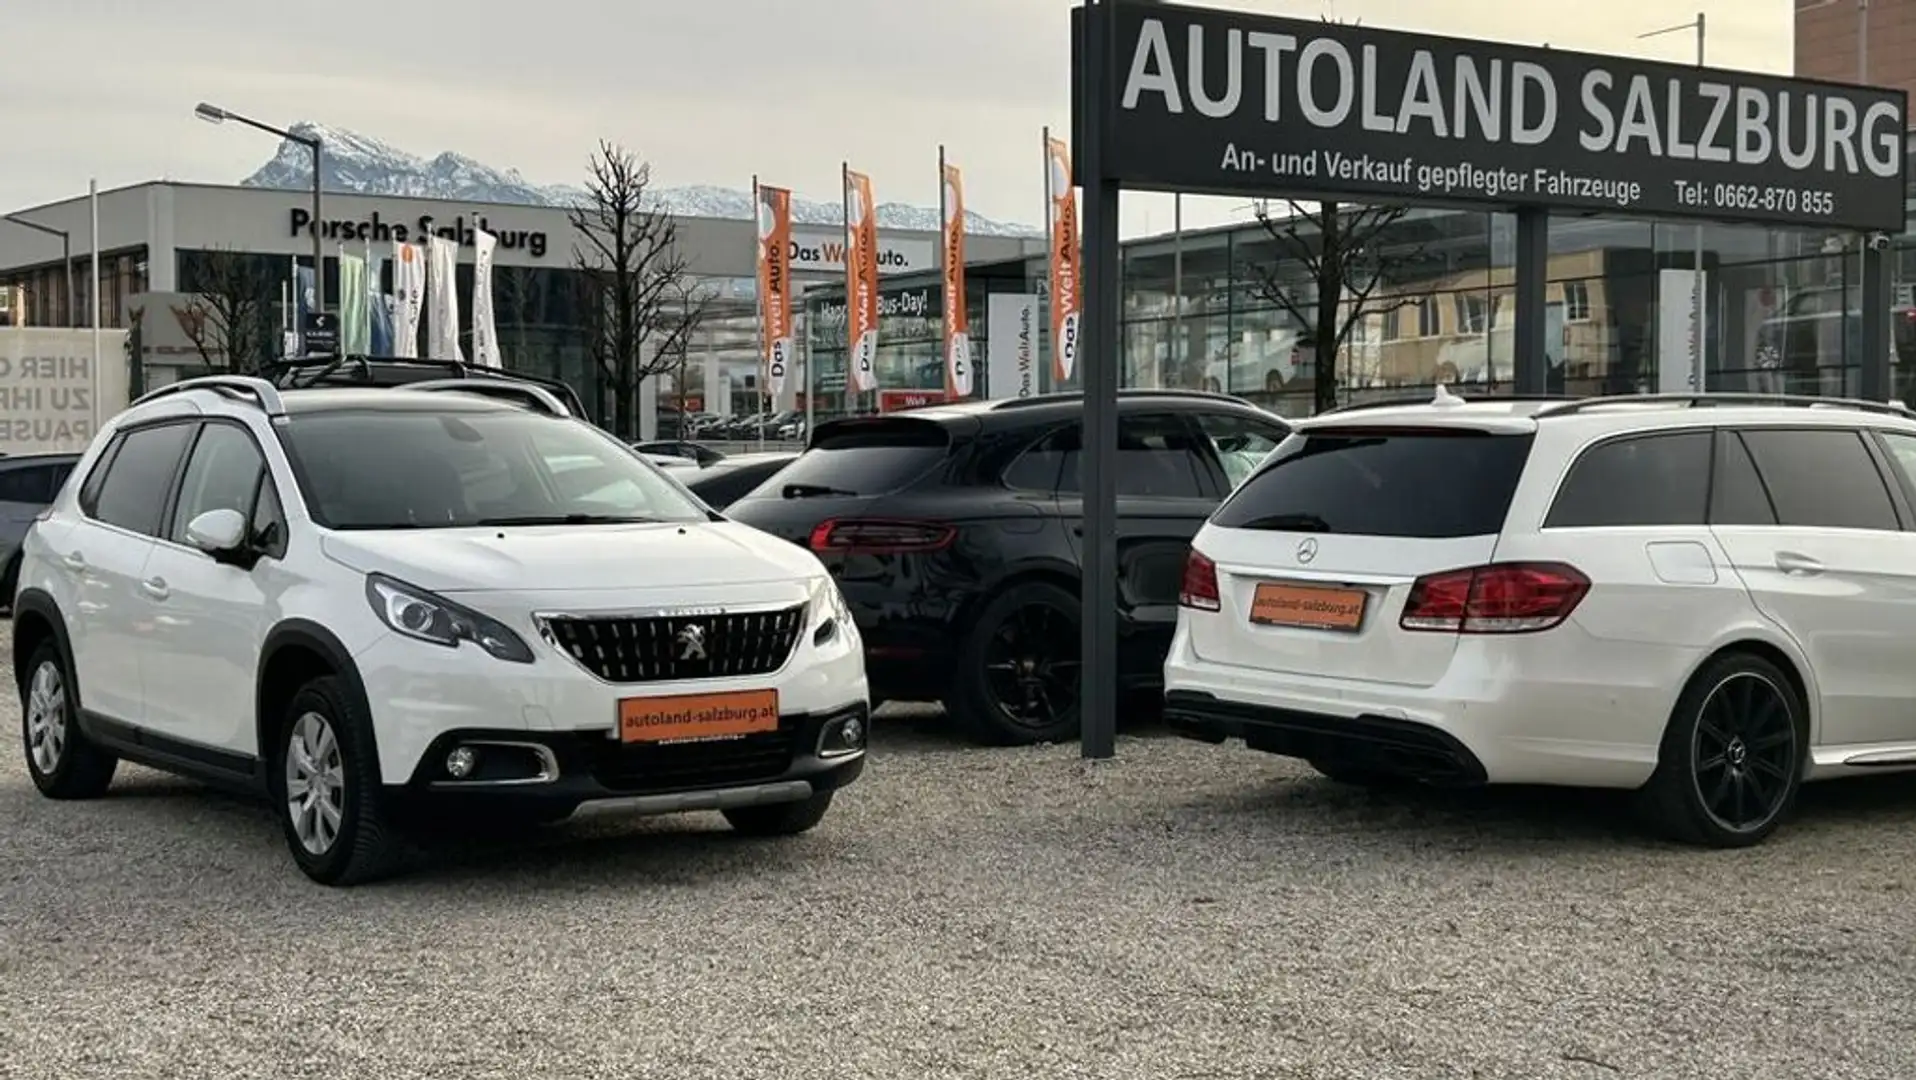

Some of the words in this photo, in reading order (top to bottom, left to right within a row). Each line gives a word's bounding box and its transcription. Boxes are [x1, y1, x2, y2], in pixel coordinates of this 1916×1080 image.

[1122, 18, 1558, 145] AUTOLAND
[1579, 68, 1900, 178] SALZBURG
[1221, 142, 1265, 172] An-
[1272, 150, 1317, 177] und
[1324, 151, 1412, 184] Verkauf
[1417, 160, 1528, 196] gepflegter
[1534, 168, 1641, 205] Fahrzeuge
[1674, 180, 1707, 205] Tel:
[1714, 183, 1797, 213] 0662-870
[1801, 190, 1834, 215] 855
[290, 207, 408, 243] Porsche
[787, 240, 820, 262] Das
[771, 341, 784, 377] Das
[1254, 596, 1360, 616] autoland-salzburg.at
[625, 705, 774, 728] autoland-salzburg.at
